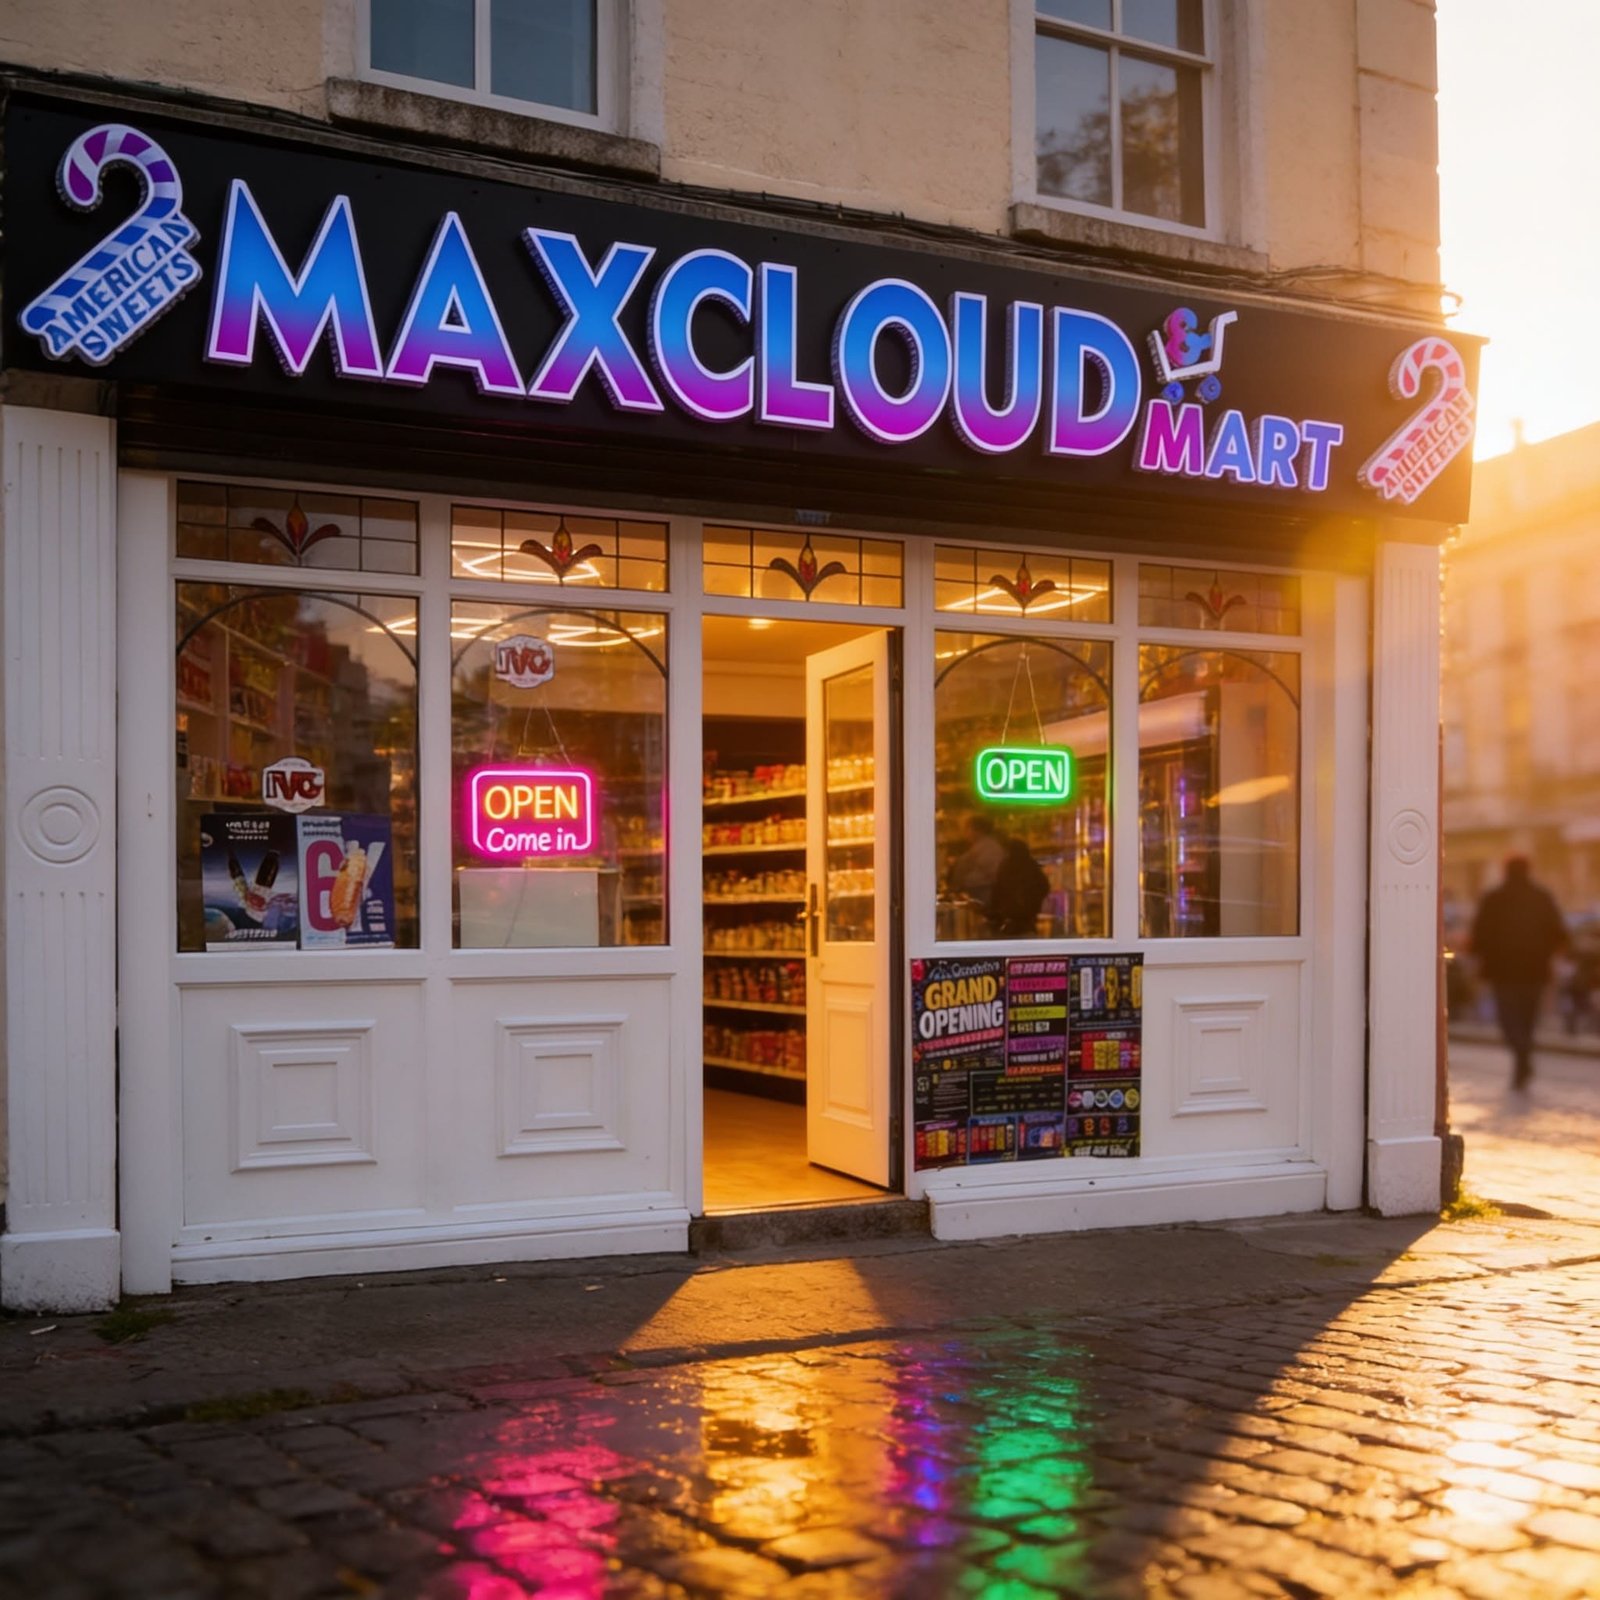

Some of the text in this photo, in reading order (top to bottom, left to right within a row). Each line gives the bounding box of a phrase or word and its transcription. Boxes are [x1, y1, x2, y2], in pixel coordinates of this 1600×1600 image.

[206, 178, 1142, 457] MAXCLOUD
[1138, 398, 1343, 491] MART
[985, 758, 1064, 793] OPEN
[484, 785, 578, 820] OPEN
[485, 827, 579, 853] Come in
[924, 974, 997, 1011] GRAND
[919, 1000, 1004, 1040] OPENING
